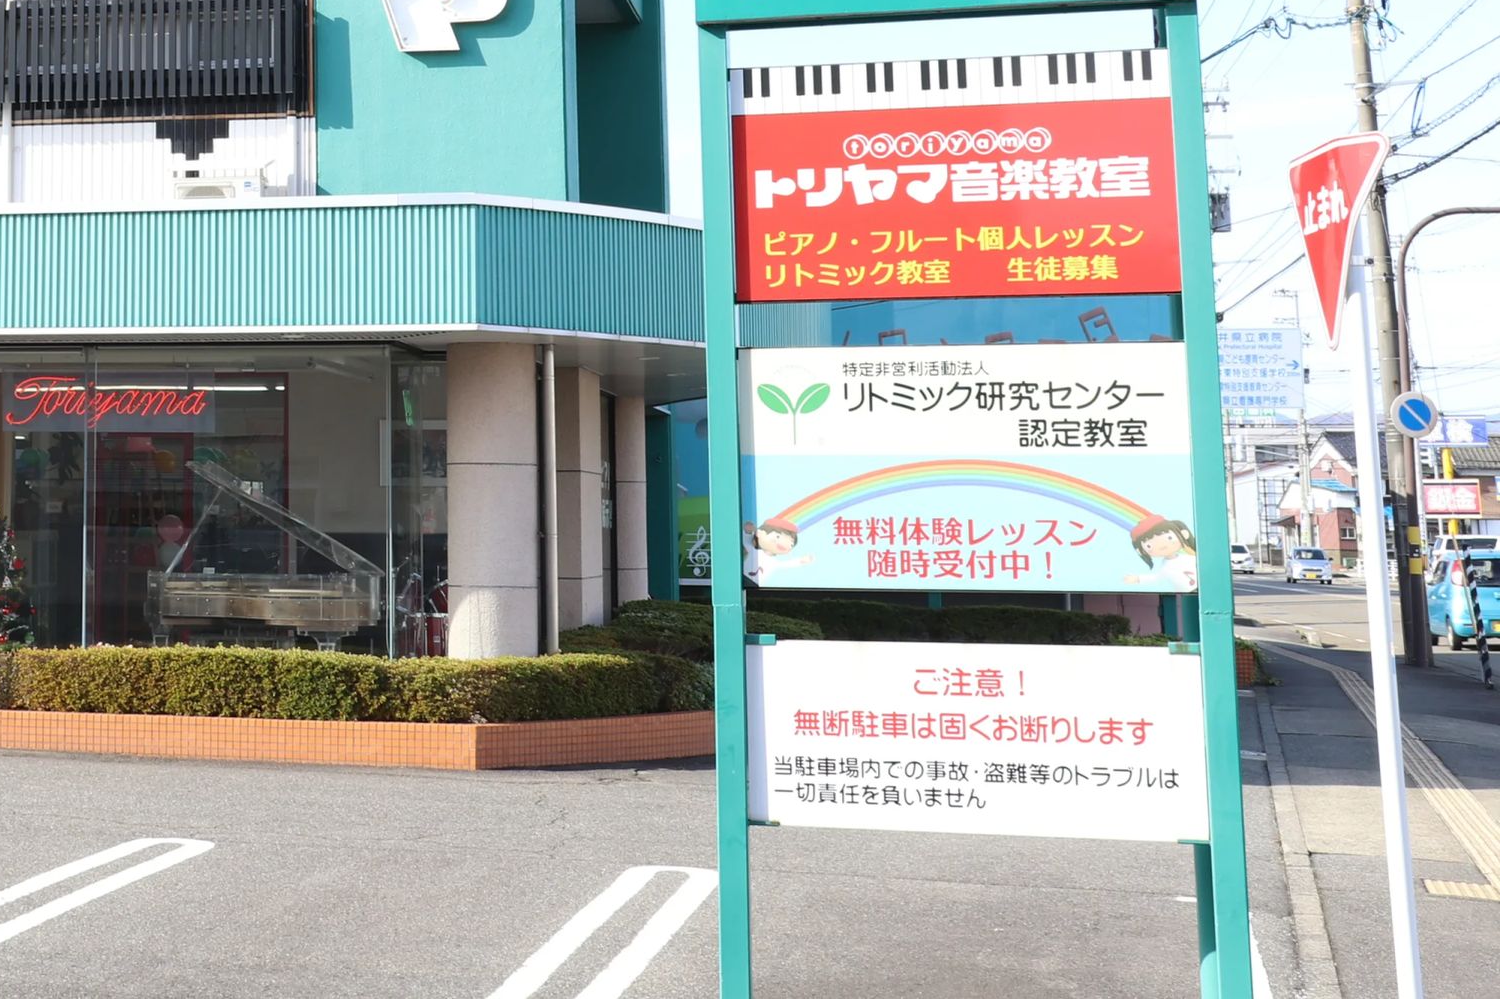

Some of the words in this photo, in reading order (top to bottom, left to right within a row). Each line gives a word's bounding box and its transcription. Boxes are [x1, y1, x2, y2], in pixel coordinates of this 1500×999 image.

[843, 126, 1052, 160] toriyama
[754, 155, 1152, 210] トリヤマ音楽教室
[1303, 180, 1349, 236] 止まれ
[764, 223, 1145, 257] ピアノ・フルート個人レッスン
[765, 258, 951, 288] リトミック教室
[1007, 254, 1120, 283] 生徒募集
[842, 360, 990, 378] 特定非営利活動法人
[6, 376, 210, 429] Toriyama
[843, 379, 1166, 413] リトミック研究センター
[1019, 418, 1148, 448] 認定教室
[832, 517, 1097, 548] 無料体験レッスン
[867, 549, 1055, 580] 随時受付中！
[913, 668, 1029, 698] ご注意！
[793, 710, 1154, 746] 無断駐車は固くお断りします
[773, 755, 1180, 790] 当駐車場内での事故・盗難等のトラブルは
[773, 783, 987, 810] 一切責任を負いません
